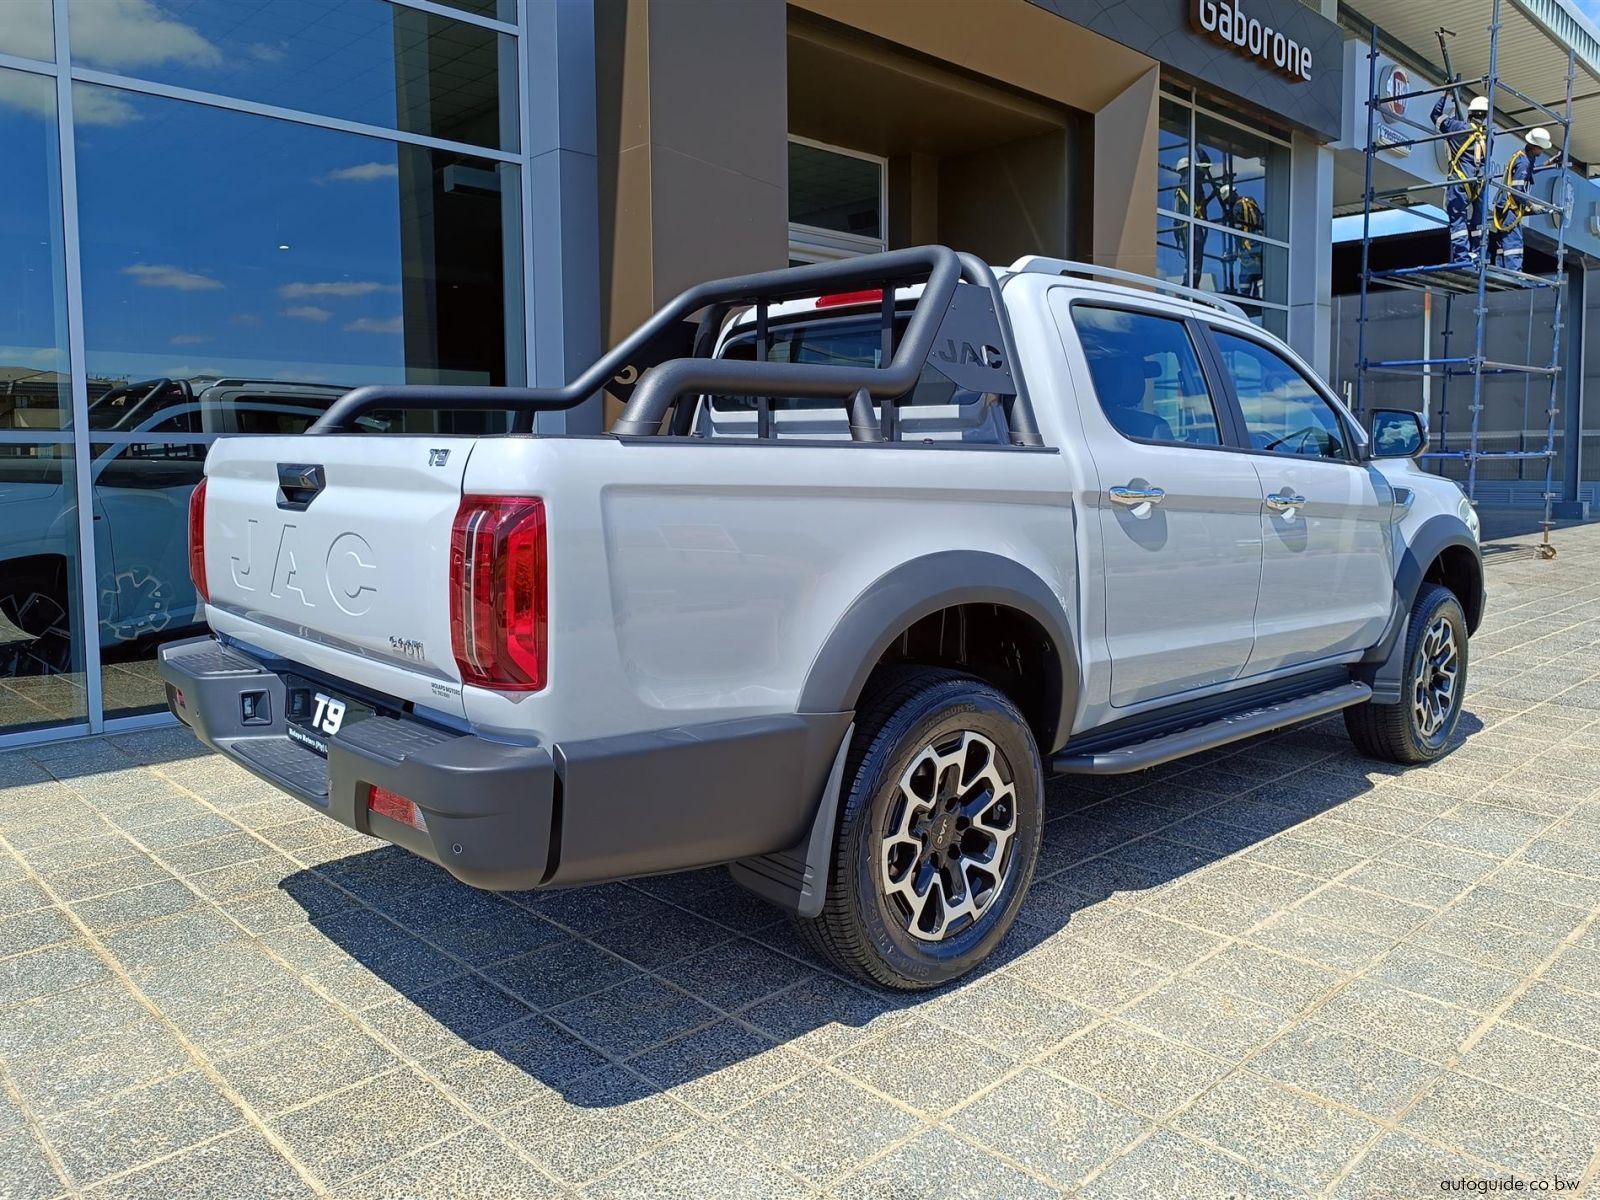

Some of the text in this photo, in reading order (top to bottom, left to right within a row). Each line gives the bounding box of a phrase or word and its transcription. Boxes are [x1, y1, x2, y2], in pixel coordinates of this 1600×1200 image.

[1199, 0, 1313, 81] Gaborone
[938, 338, 1003, 370] JAC
[428, 448, 452, 467] T9
[230, 518, 378, 617] JAC
[311, 692, 347, 736] T9
